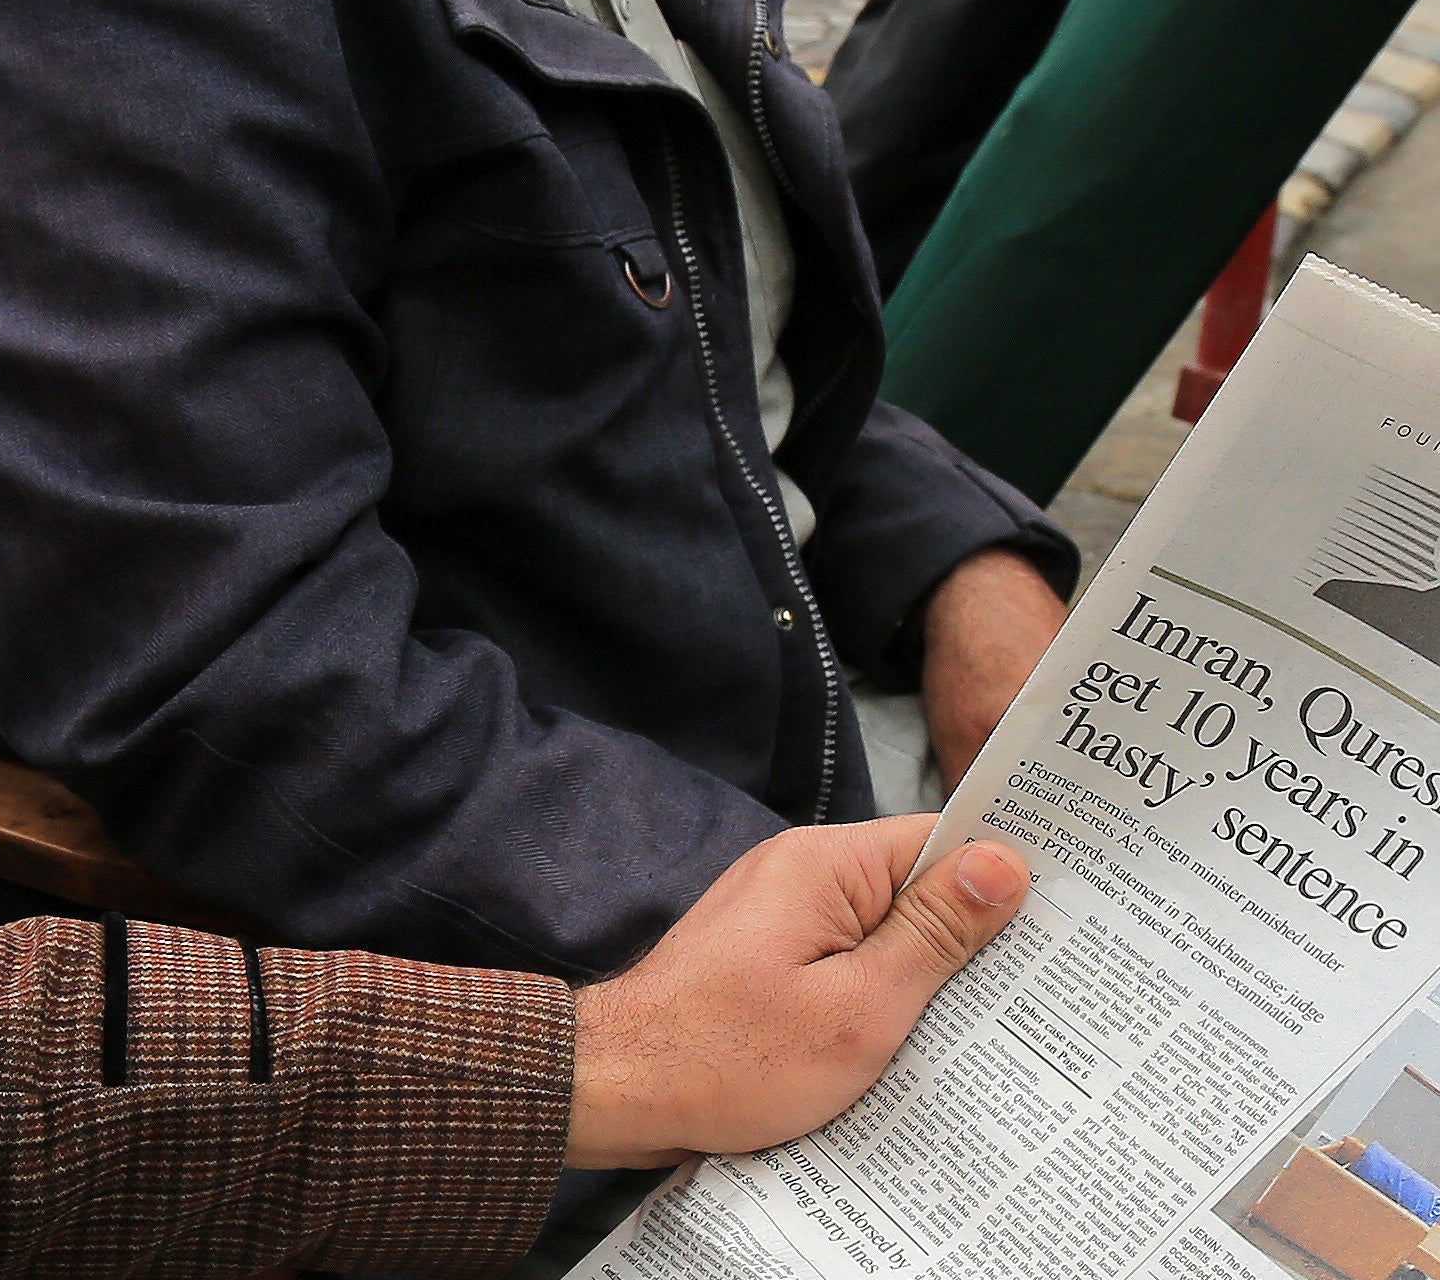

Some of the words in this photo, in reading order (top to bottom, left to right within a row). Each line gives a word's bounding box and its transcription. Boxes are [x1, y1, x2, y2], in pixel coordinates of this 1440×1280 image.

[1110, 590, 1274, 712] Imran,
[1006, 773, 1065, 806] Official
[1062, 797, 1117, 839] Secrets
[1114, 832, 1144, 858] Act
[1025, 760, 1083, 794] Former
[1077, 789, 1141, 834] premier,
[1141, 823, 1191, 866] foreign
[1188, 860, 1246, 903] minister
[1239, 898, 1308, 946] punished
[1301, 940, 1345, 973] under
[1054, 701, 1215, 808] 'hasty'
[1210, 806, 1408, 950] sentence
[1068, 660, 1162, 713] get
[1164, 689, 1236, 748] 10
[1224, 735, 1368, 839] years
[1364, 814, 1425, 882] in
[980, 810, 1040, 846] declines
[1039, 836, 1074, 865] PTI
[1068, 856, 1129, 907] founder's
[1125, 901, 1173, 939] request
[1168, 931, 1194, 953] for
[1189, 949, 1304, 1036] cross-examination
[1000, 797, 1053, 832] Bushra
[1053, 825, 1107, 867] records
[1104, 860, 1167, 909] statement
[1162, 900, 1180, 920] in
[1178, 910, 1255, 974] Toshakhana
[1252, 969, 1288, 999] case;
[1279, 992, 1325, 1024] judge
